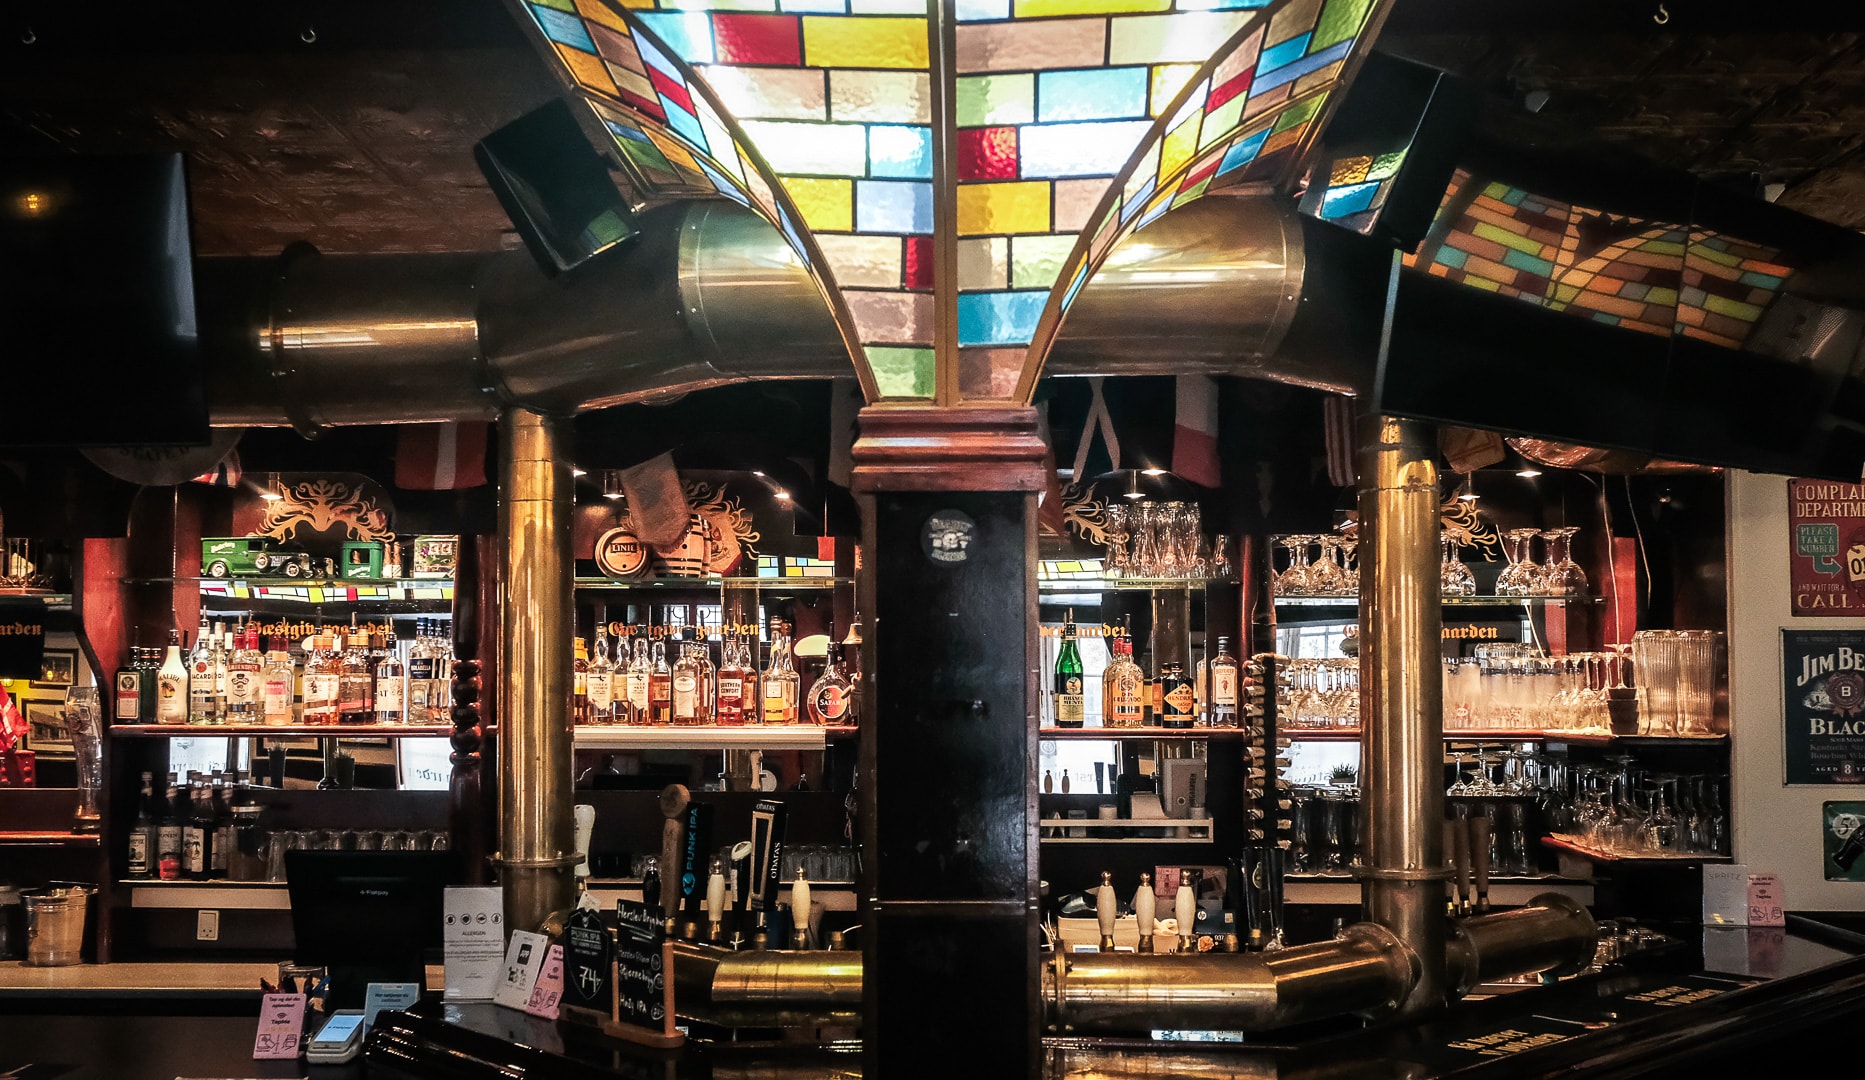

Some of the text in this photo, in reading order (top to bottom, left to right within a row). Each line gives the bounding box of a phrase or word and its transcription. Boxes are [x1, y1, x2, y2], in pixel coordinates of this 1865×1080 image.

[1801, 526, 1833, 535] PLEASE
[1801, 535, 1834, 544] TAKE A
[1801, 544, 1835, 553] NUMBER
[1441, 623, 1498, 639] aarden
[1797, 653, 1835, 687] JIM
[1809, 717, 1865, 735] BLAC
[1844, 763, 1852, 775] 8
[686, 807, 698, 870] PUNK IPA
[637, 1000, 648, 1014] IPA
